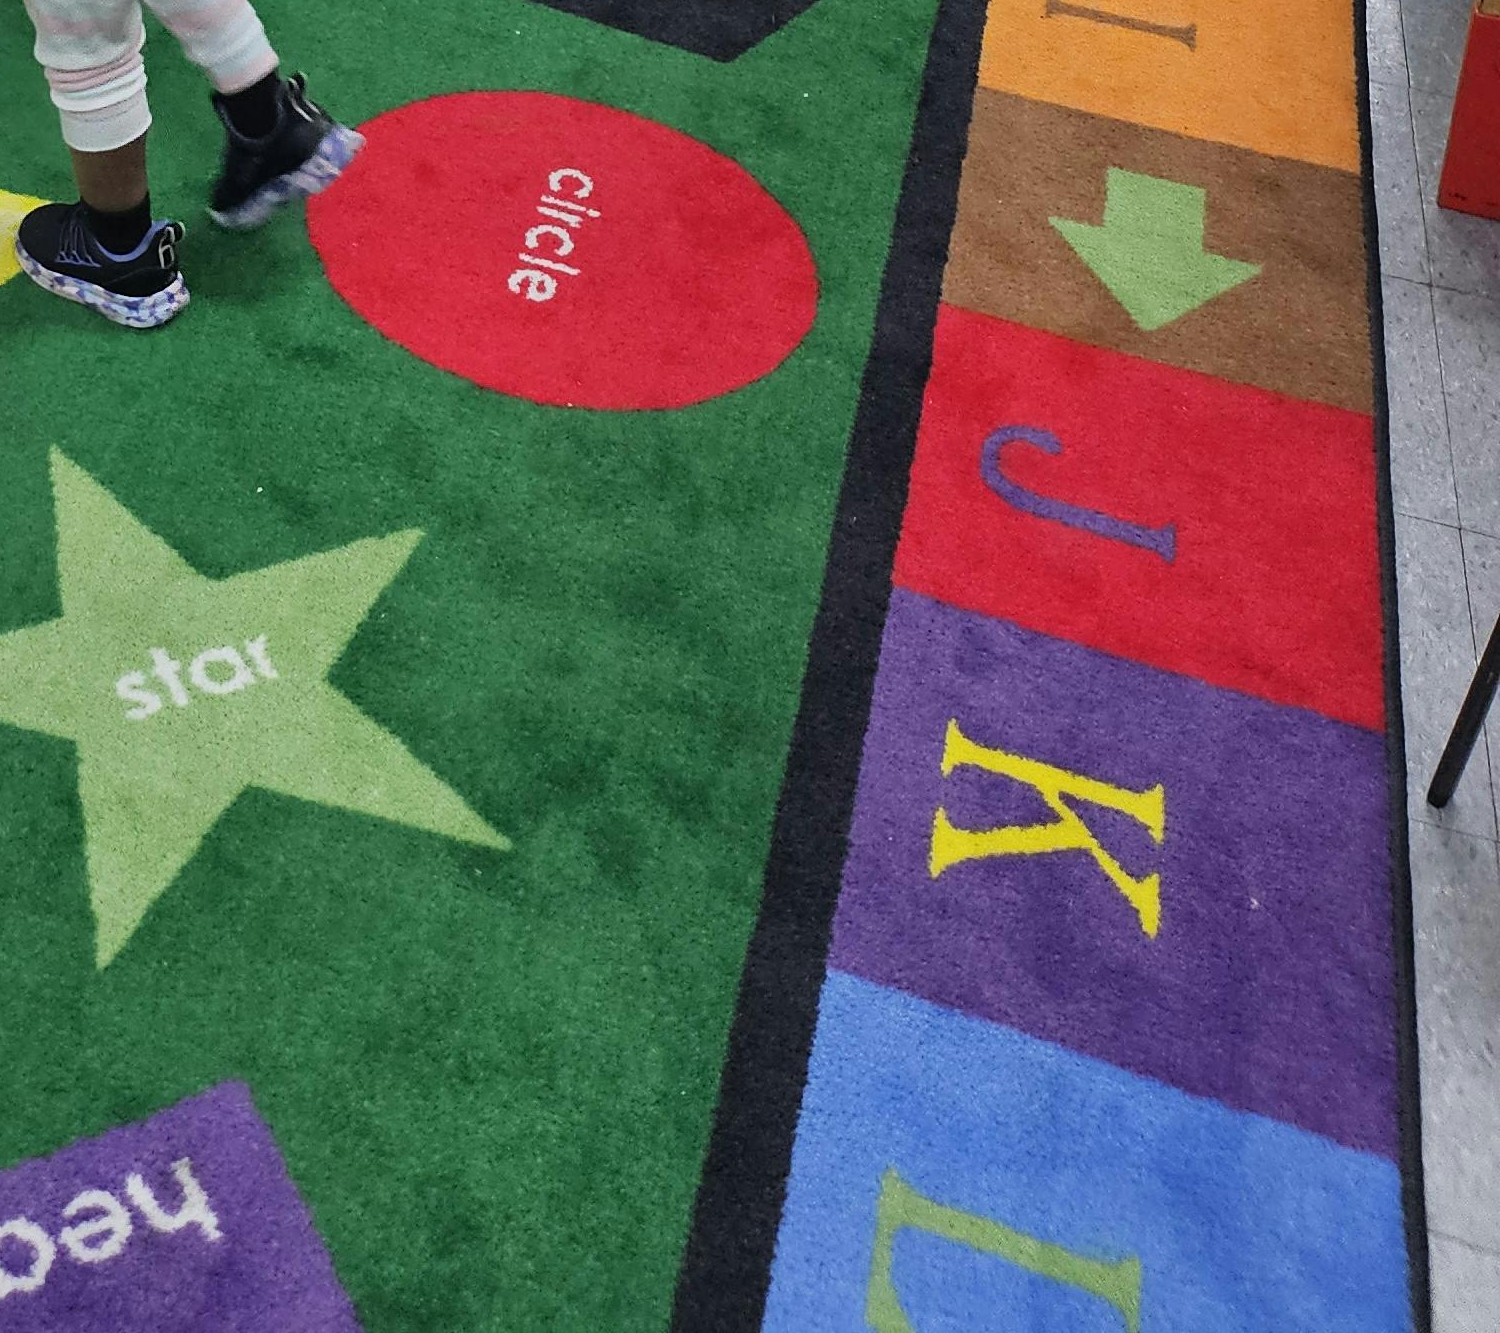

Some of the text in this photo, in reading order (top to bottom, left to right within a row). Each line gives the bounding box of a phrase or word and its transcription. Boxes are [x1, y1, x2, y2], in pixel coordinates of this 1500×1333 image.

[505, 167, 596, 305] circle
[981, 424, 1177, 566] J
[114, 634, 279, 722] star
[928, 718, 1165, 939] K
